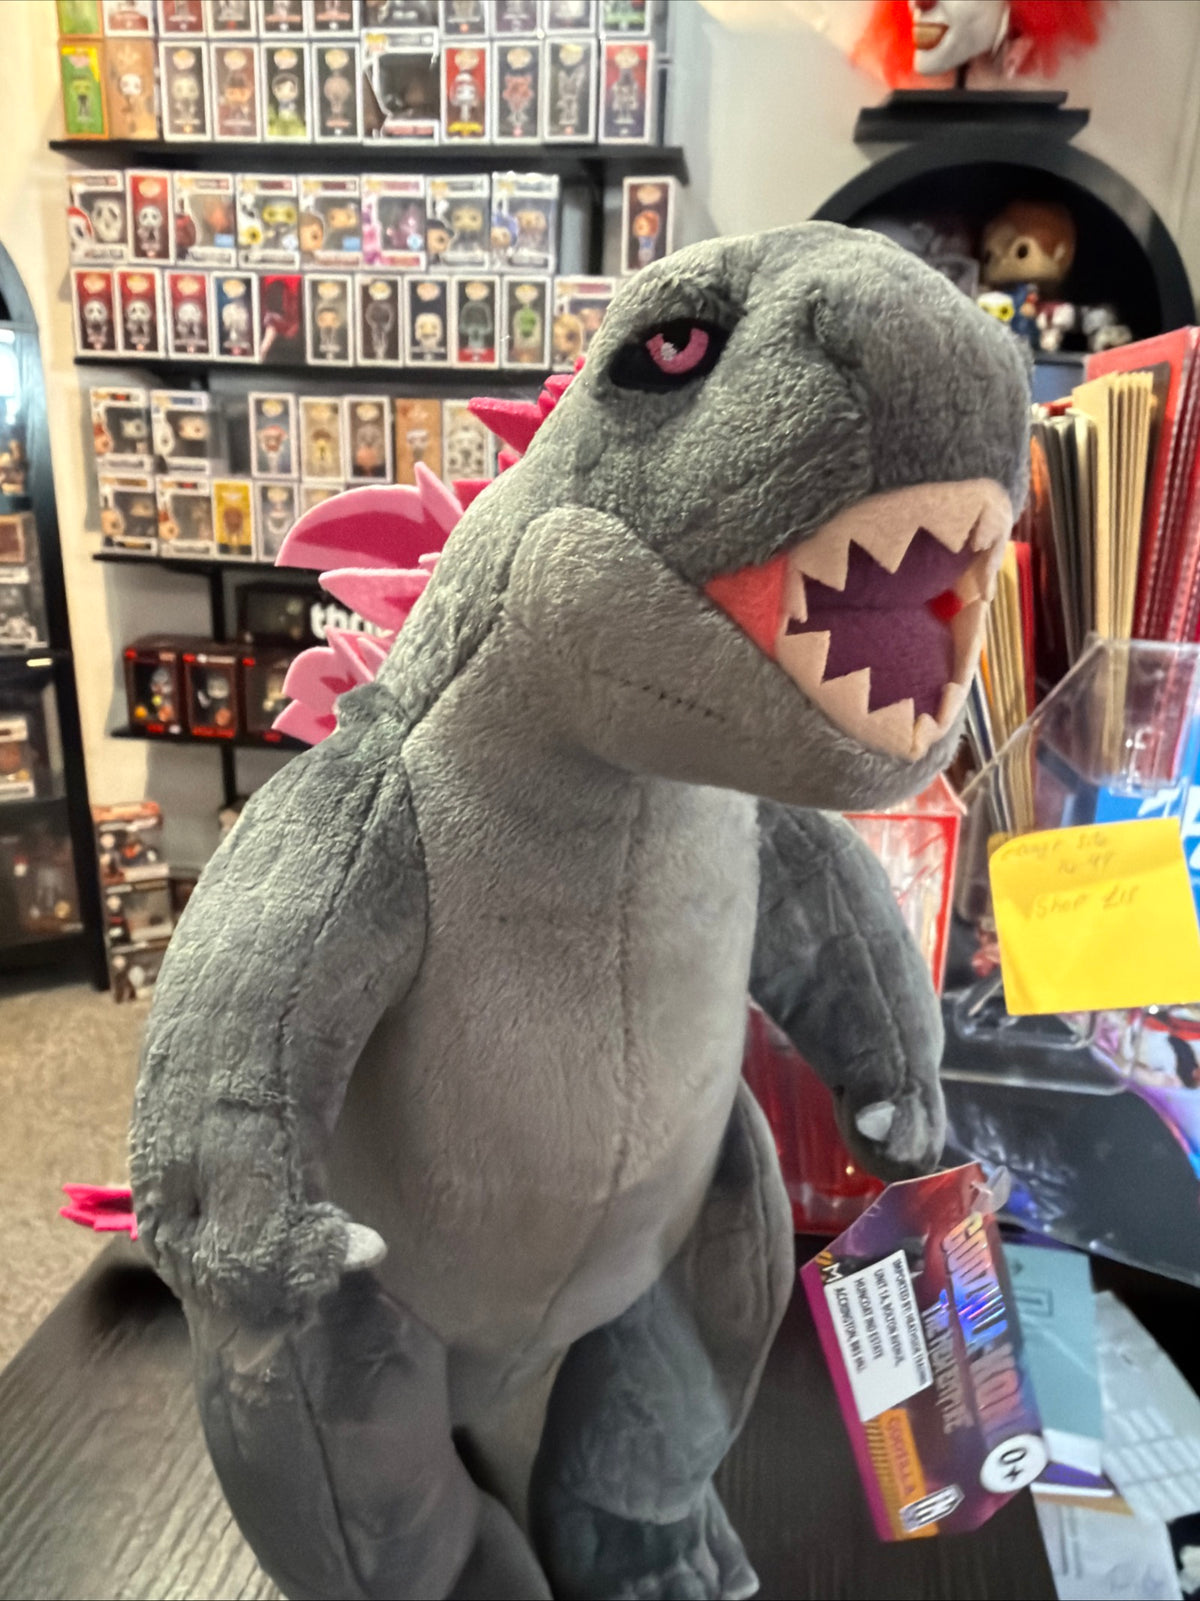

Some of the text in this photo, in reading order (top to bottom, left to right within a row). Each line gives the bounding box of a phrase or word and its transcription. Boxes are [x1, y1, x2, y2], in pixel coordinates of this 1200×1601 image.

[873, 1268, 886, 1289] UNIT
[881, 1302, 897, 1335] BOLTON
[892, 1258, 908, 1301] IMPORTED
[941, 1211, 1008, 1357] GODZILLA
[853, 1277, 872, 1317] HUNCOAT
[868, 1331, 883, 1359] ESTATE
[999, 1445, 1027, 1482] 0+
